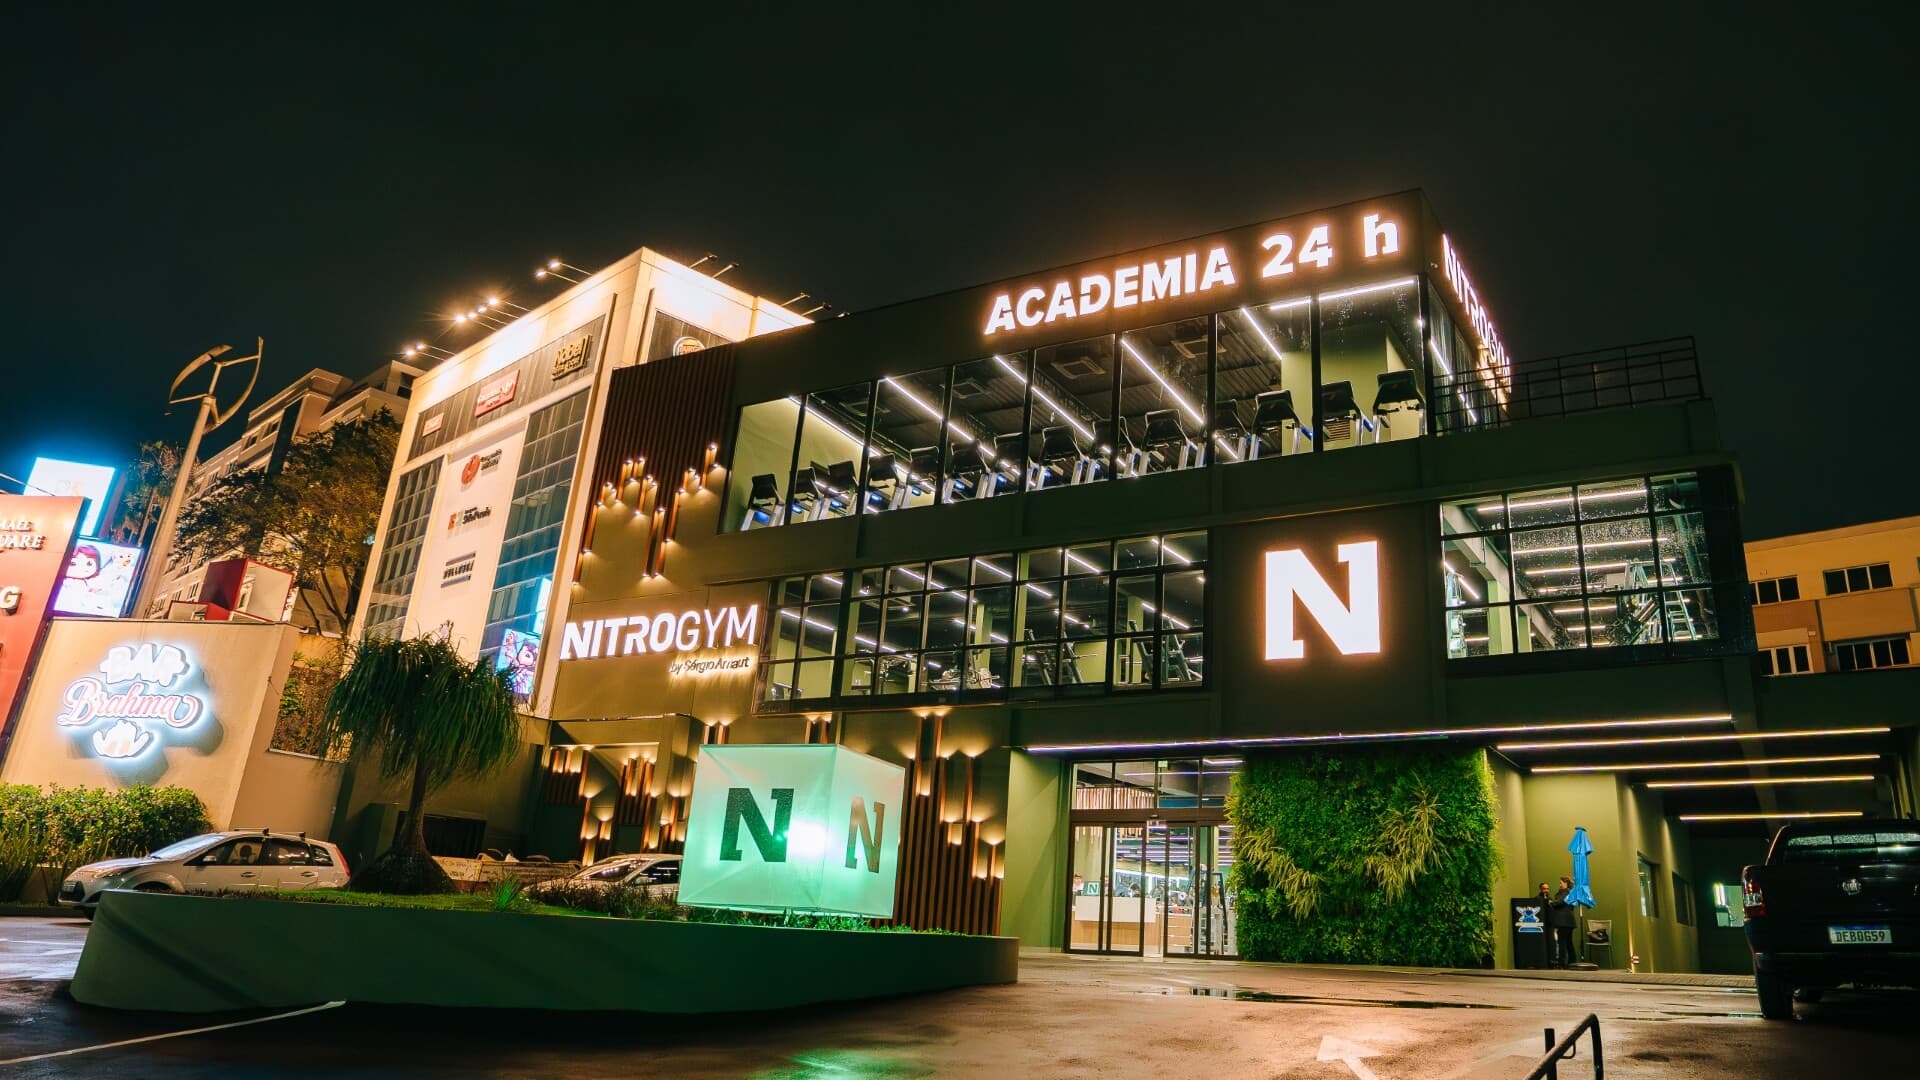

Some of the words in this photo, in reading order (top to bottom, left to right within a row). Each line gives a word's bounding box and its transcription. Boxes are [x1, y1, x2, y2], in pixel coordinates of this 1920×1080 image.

[984, 247, 1236, 335] ACADEMIA
[1262, 225, 1333, 278] 24
[1363, 213, 1399, 258] h
[560, 604, 758, 659] NITROGYM
[1265, 541, 1380, 660] N
[56, 677, 201, 728] Brahma
[670, 661, 683, 674] by
[719, 788, 795, 863] N
[845, 796, 886, 873] N
